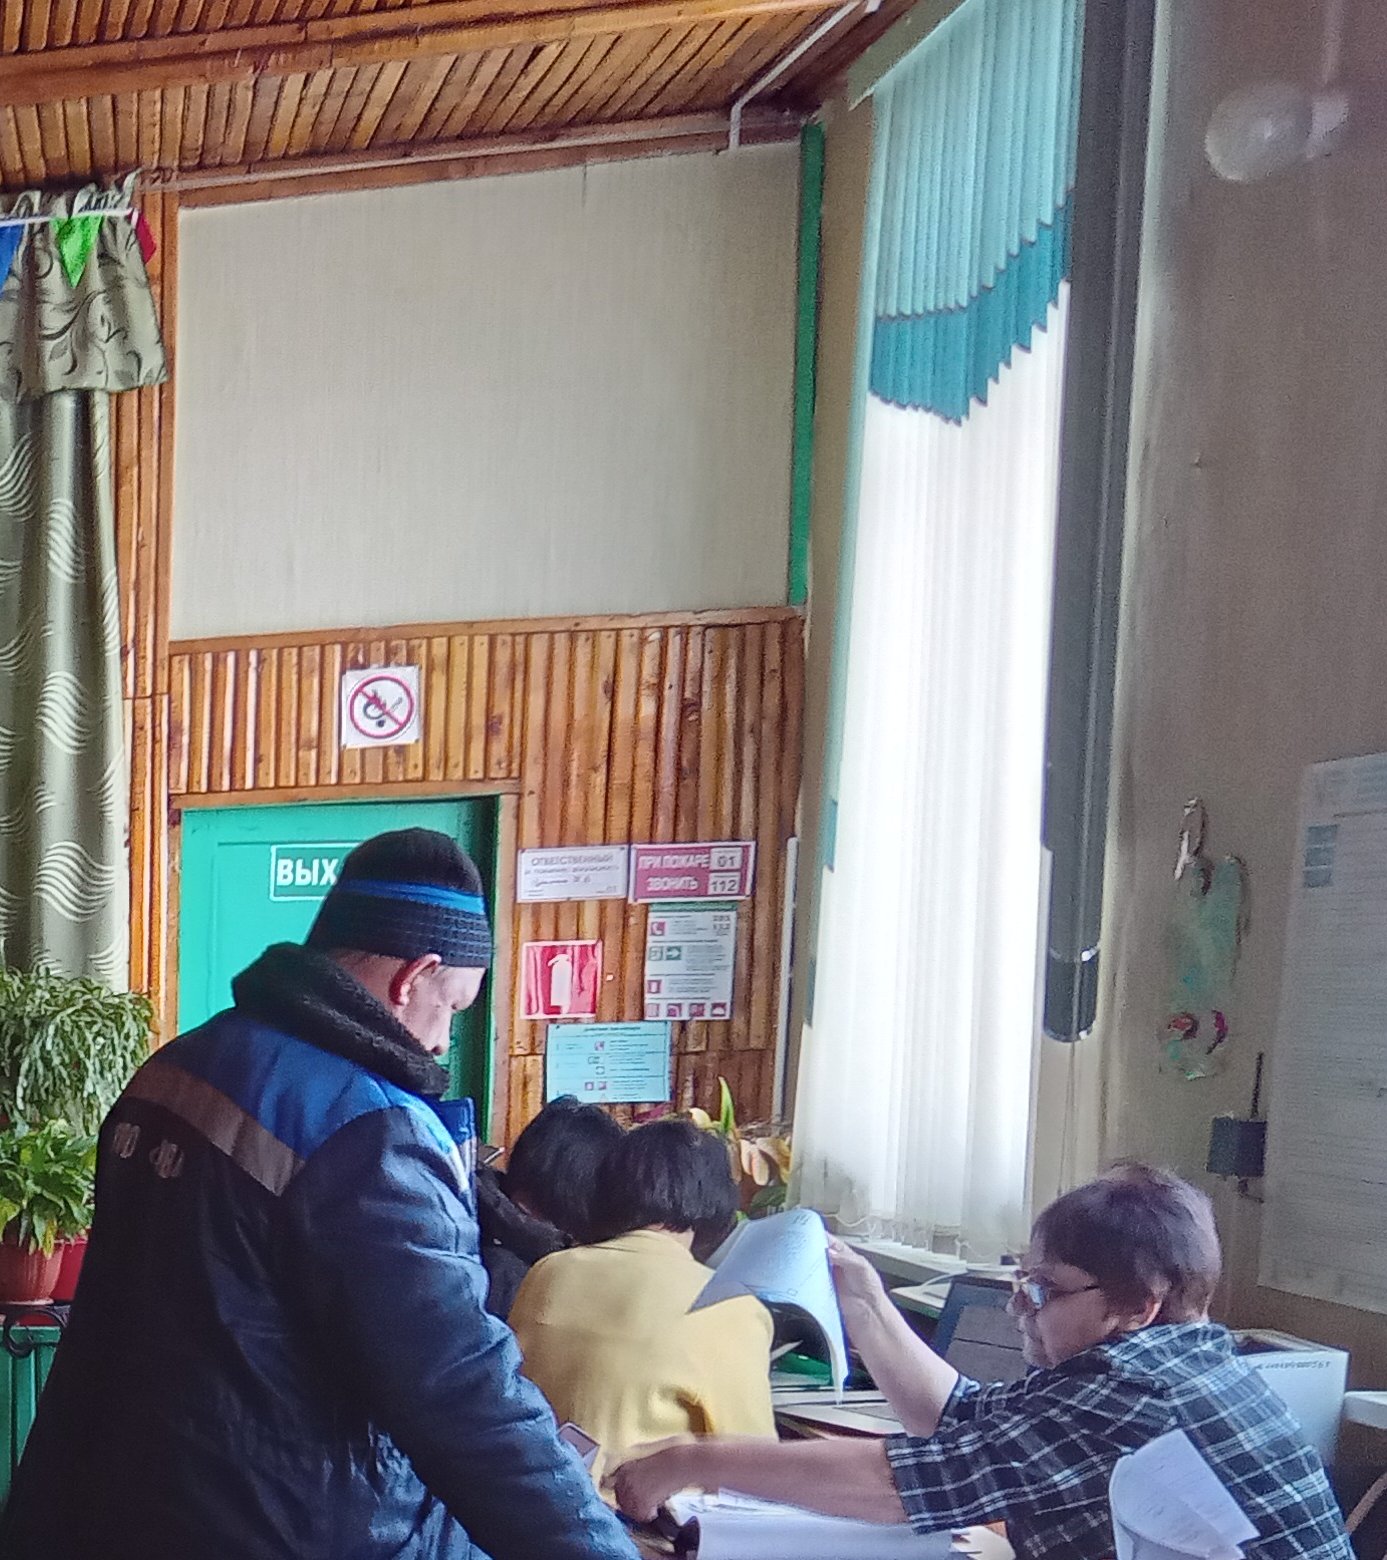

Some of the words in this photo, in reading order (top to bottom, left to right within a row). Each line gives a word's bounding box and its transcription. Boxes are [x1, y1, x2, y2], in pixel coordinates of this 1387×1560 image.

[716, 853, 736, 868] 01
[276, 858, 339, 886] ВЫХ
[710, 877, 736, 893] 112
